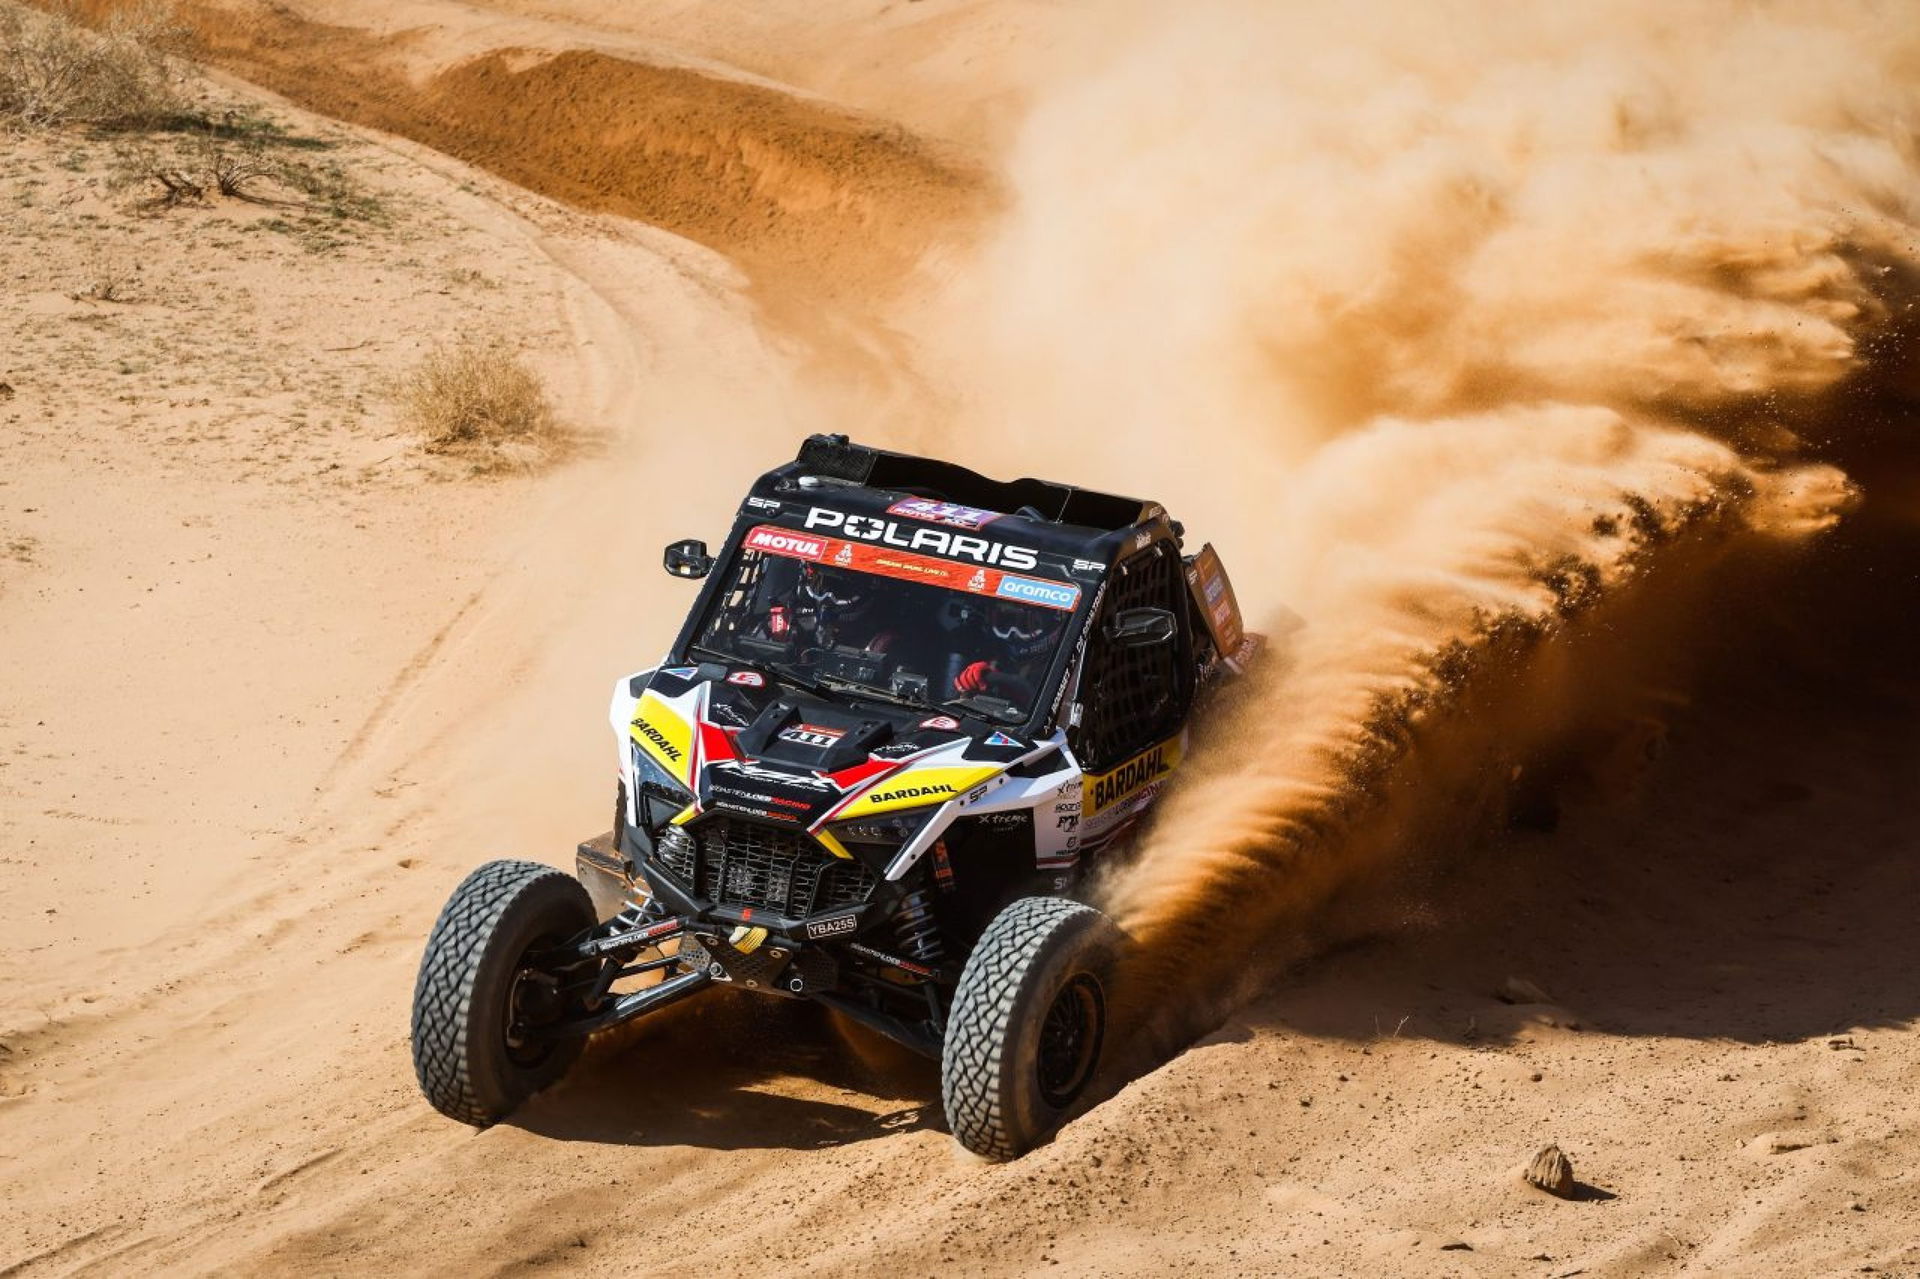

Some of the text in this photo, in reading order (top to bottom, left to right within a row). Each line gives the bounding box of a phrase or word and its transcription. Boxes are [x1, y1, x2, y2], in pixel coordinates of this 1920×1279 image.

[748, 497, 781, 509] SP
[752, 533, 820, 555] MOTUL
[804, 506, 1039, 571] POLARIS
[1073, 559, 1107, 571] SP
[1004, 581, 1071, 602] aramco
[631, 718, 682, 762] BARDAHL
[782, 731, 832, 746] 411
[1095, 747, 1170, 811] BARDAHL
[870, 784, 957, 804] BARDAHL
[969, 785, 988, 804] SP
[810, 919, 855, 935] YBA25S
